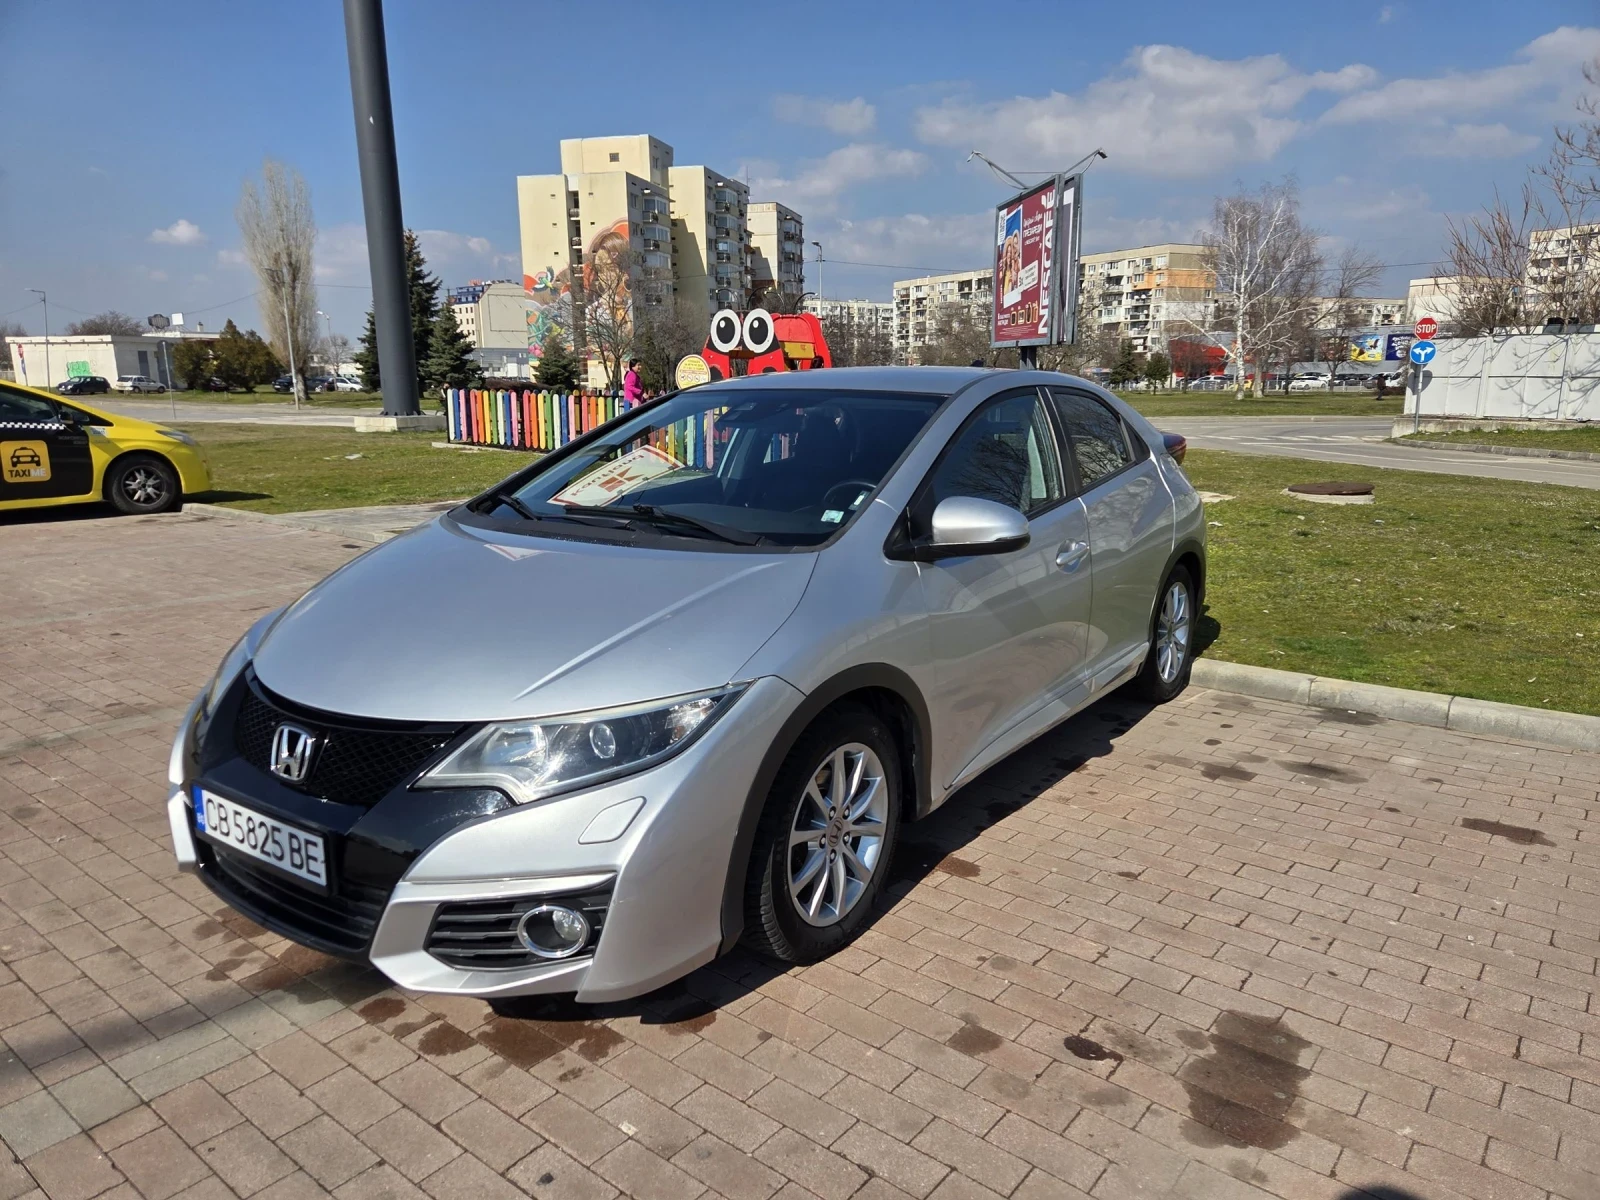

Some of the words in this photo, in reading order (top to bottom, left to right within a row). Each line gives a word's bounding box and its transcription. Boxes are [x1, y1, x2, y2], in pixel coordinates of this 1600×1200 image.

[1037, 188, 1055, 334] NESCAFÉ
[1416, 323, 1437, 334] STOP
[205, 797, 231, 838] CB
[233, 809, 285, 862] 5825
[287, 831, 321, 879] BE
